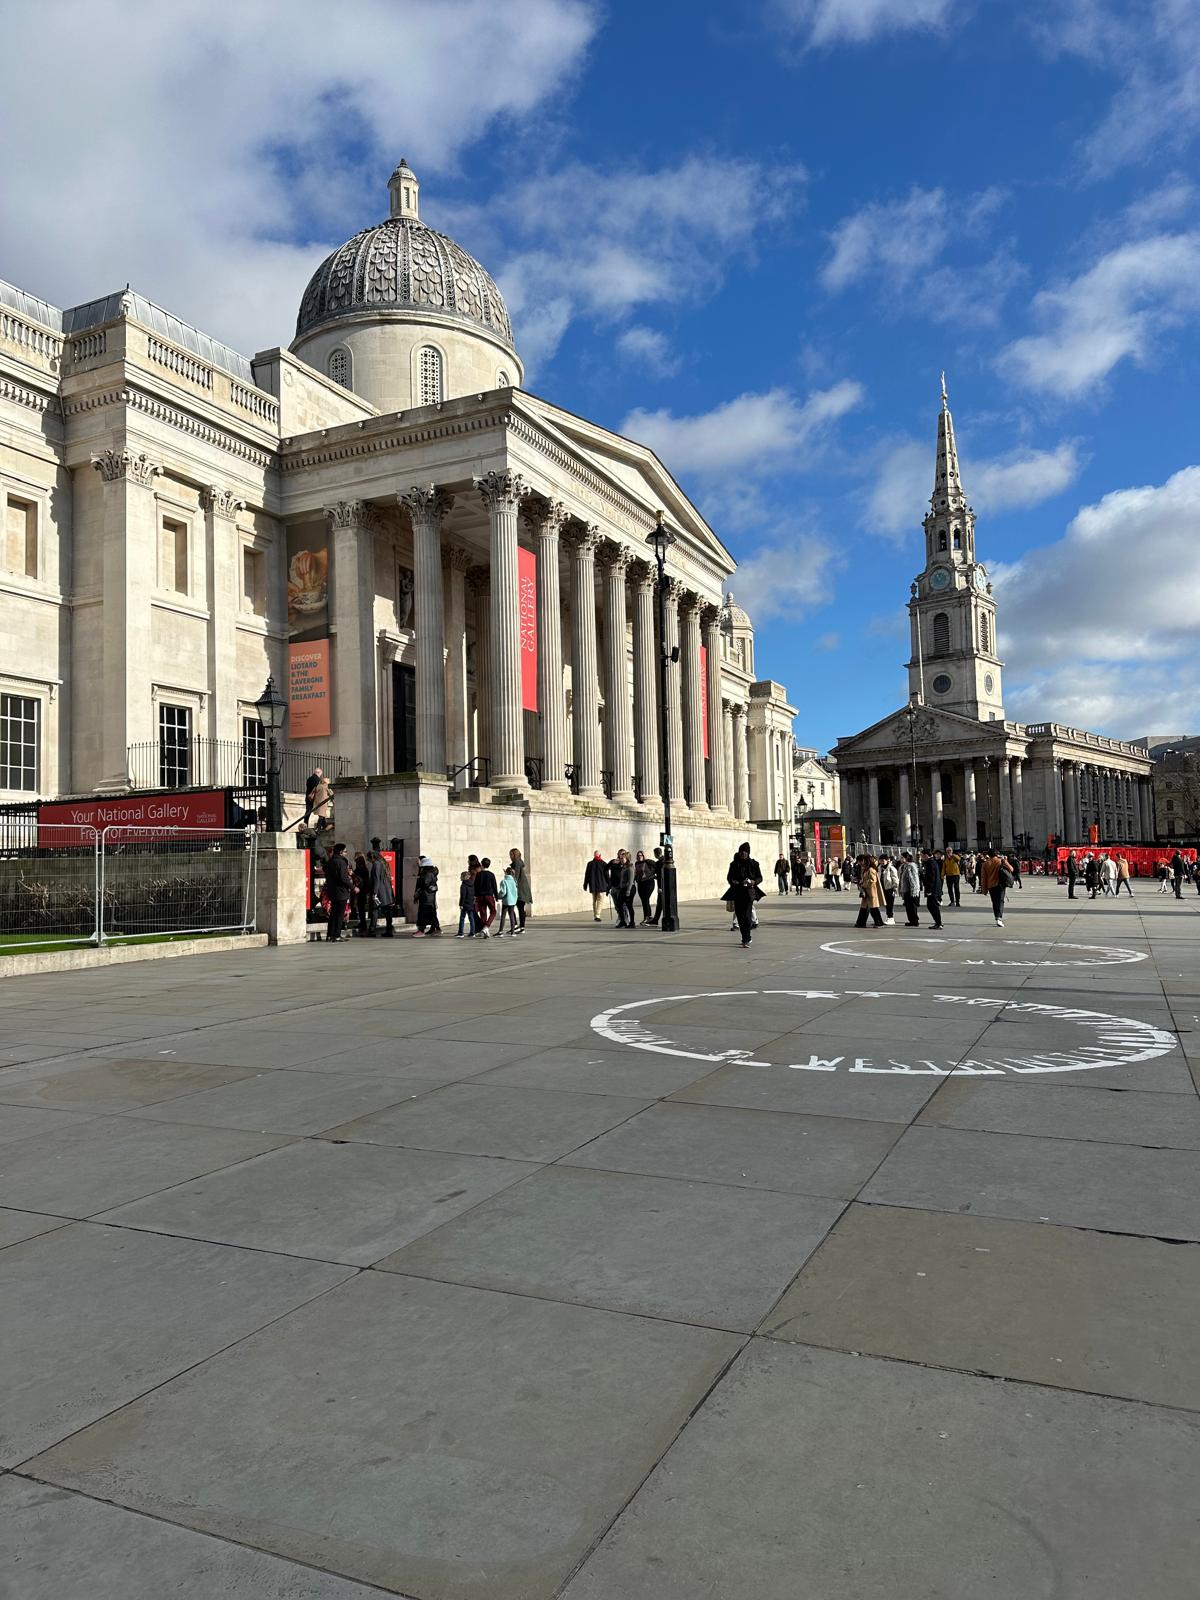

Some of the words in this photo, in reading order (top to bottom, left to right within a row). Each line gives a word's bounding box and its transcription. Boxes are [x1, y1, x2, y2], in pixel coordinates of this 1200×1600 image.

[527, 578, 535, 652] GALLERY
[291, 654, 322, 662] DISCOVER
[291, 662, 317, 670] LIOTARD
[291, 676, 323, 685] LAVERGNE
[292, 692, 326, 700] BREAKFAST
[71, 809, 95, 824] Your
[97, 805, 144, 822] National
[147, 803, 189, 821] Gallery
[80, 826, 102, 840] Free
[107, 824, 123, 839] for
